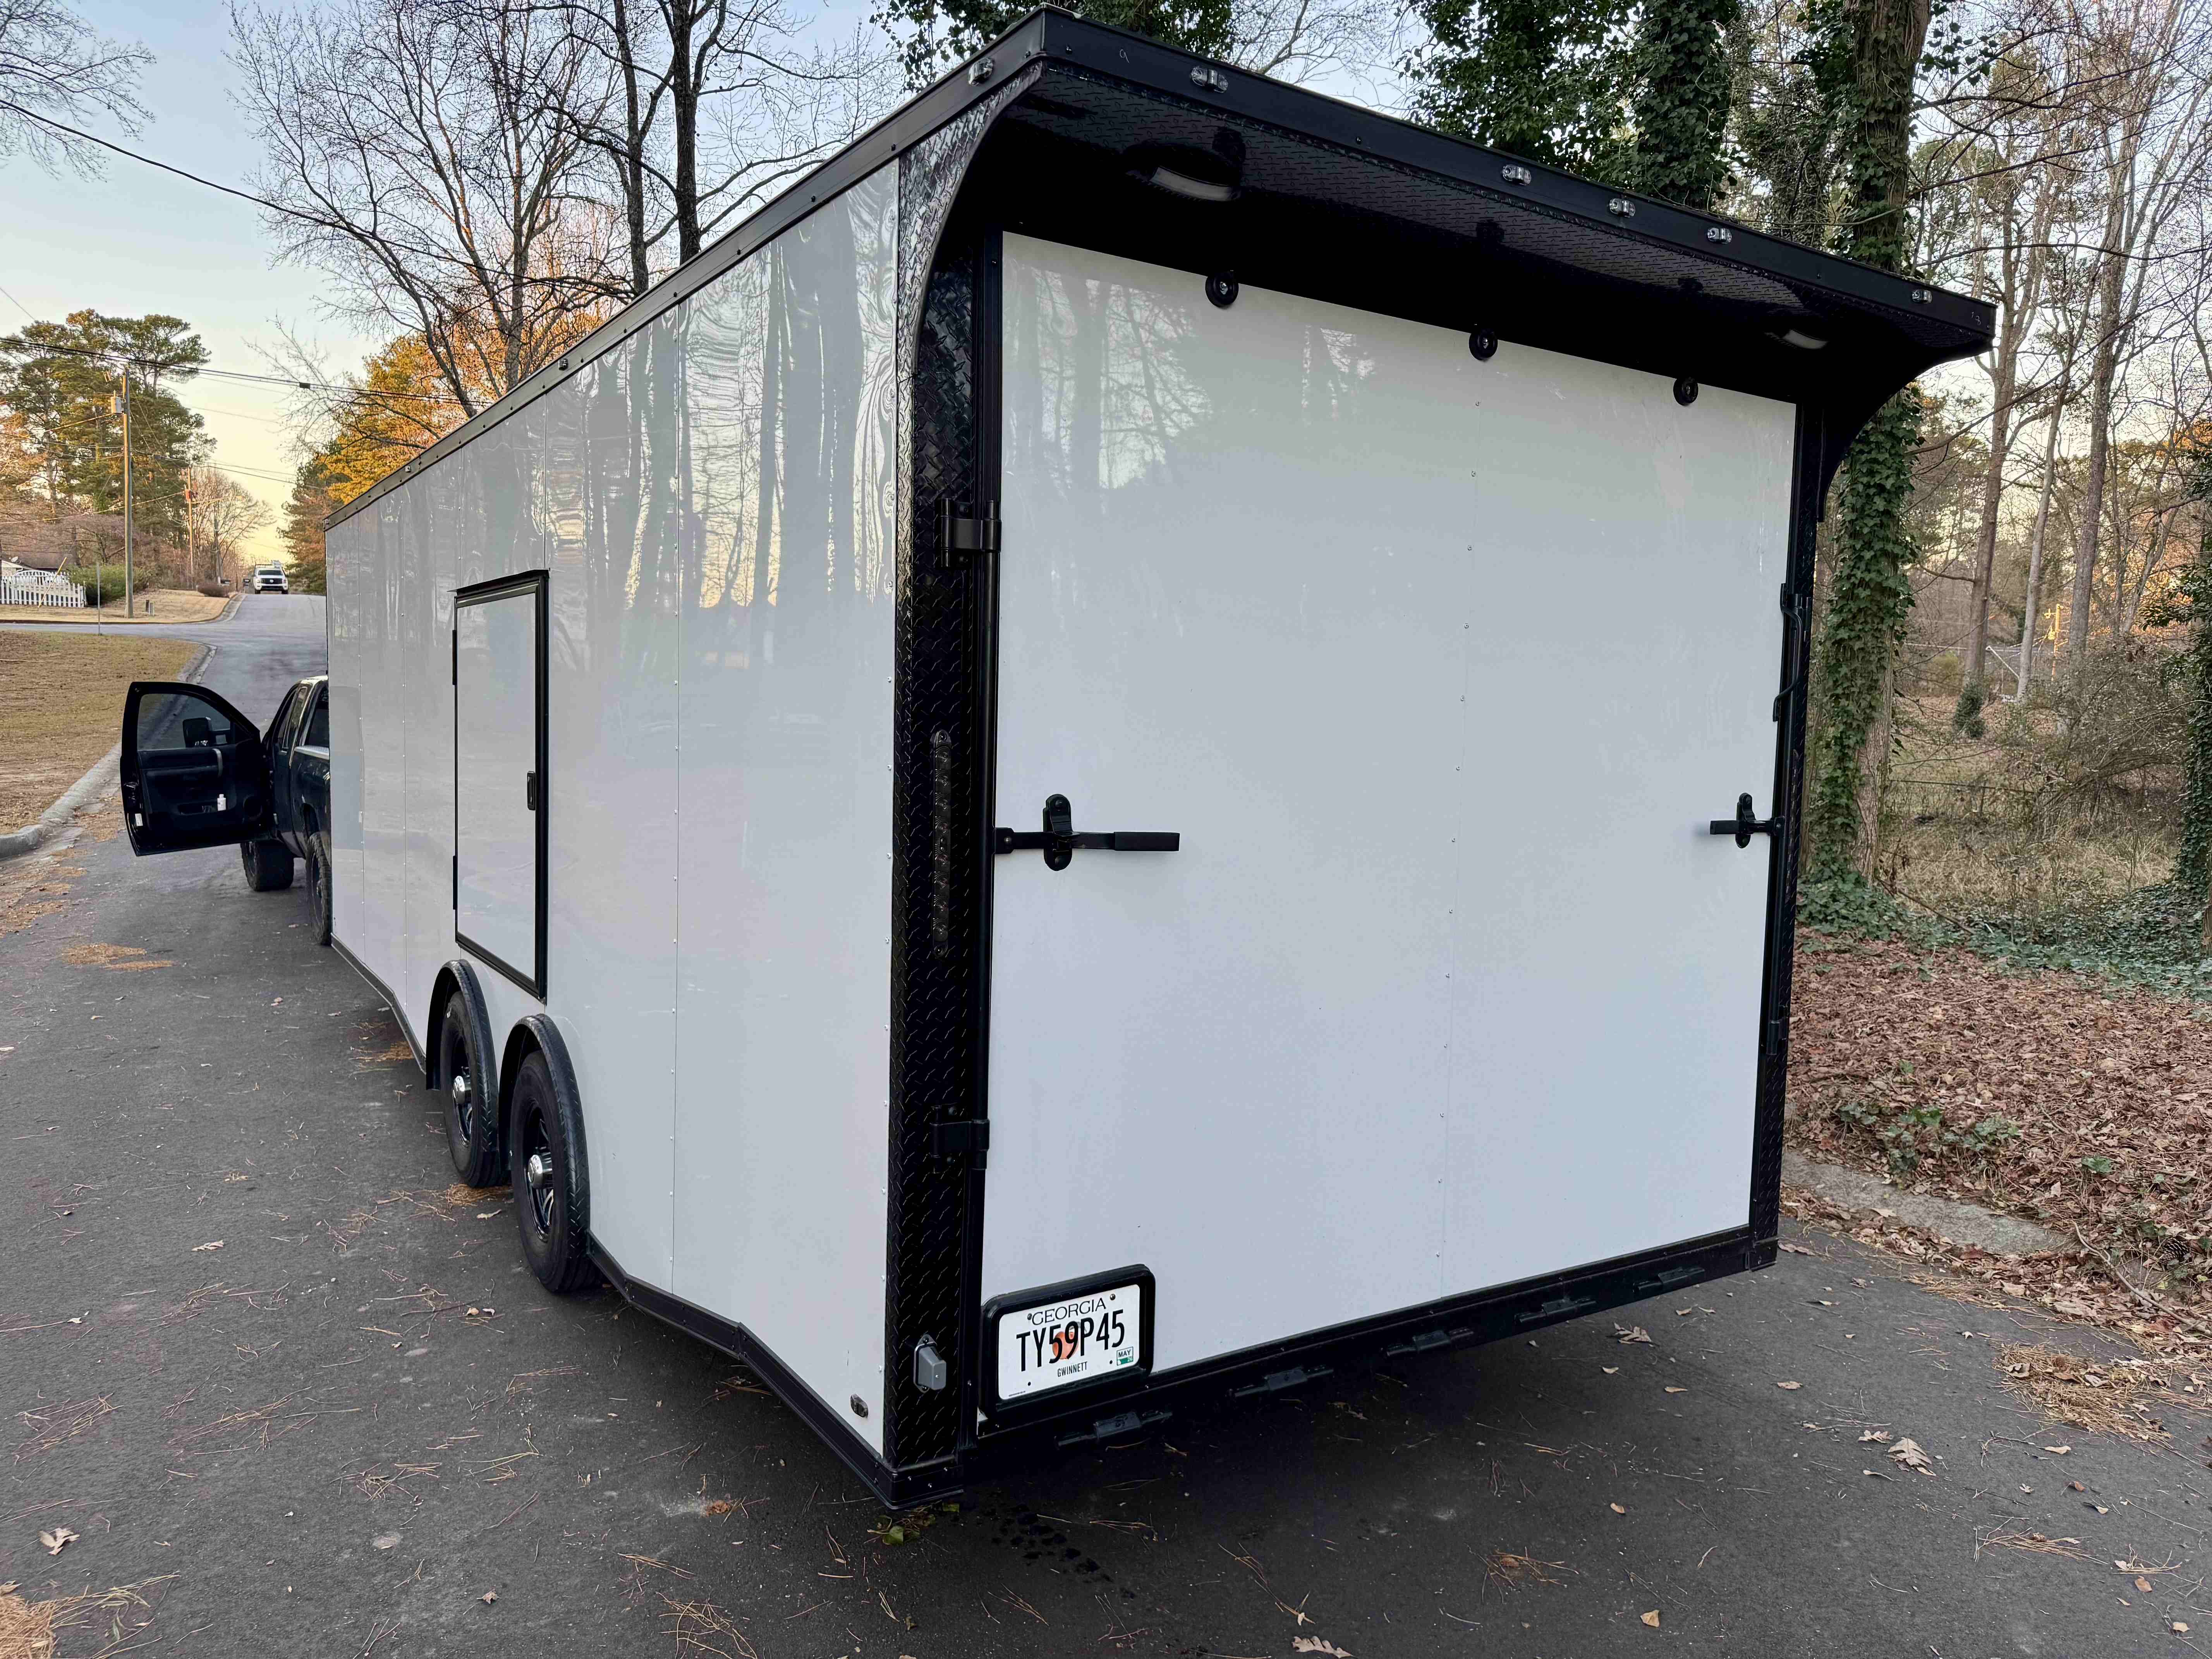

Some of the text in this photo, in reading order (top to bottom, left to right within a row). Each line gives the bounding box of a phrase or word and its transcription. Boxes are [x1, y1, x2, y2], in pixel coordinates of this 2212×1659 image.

[1032, 1298, 1106, 1325] GEORGIA
[1016, 1309, 1125, 1372] TY59P45
[1118, 1349, 1131, 1357] MAY
[1057, 1362, 1088, 1377] GWINNETT
